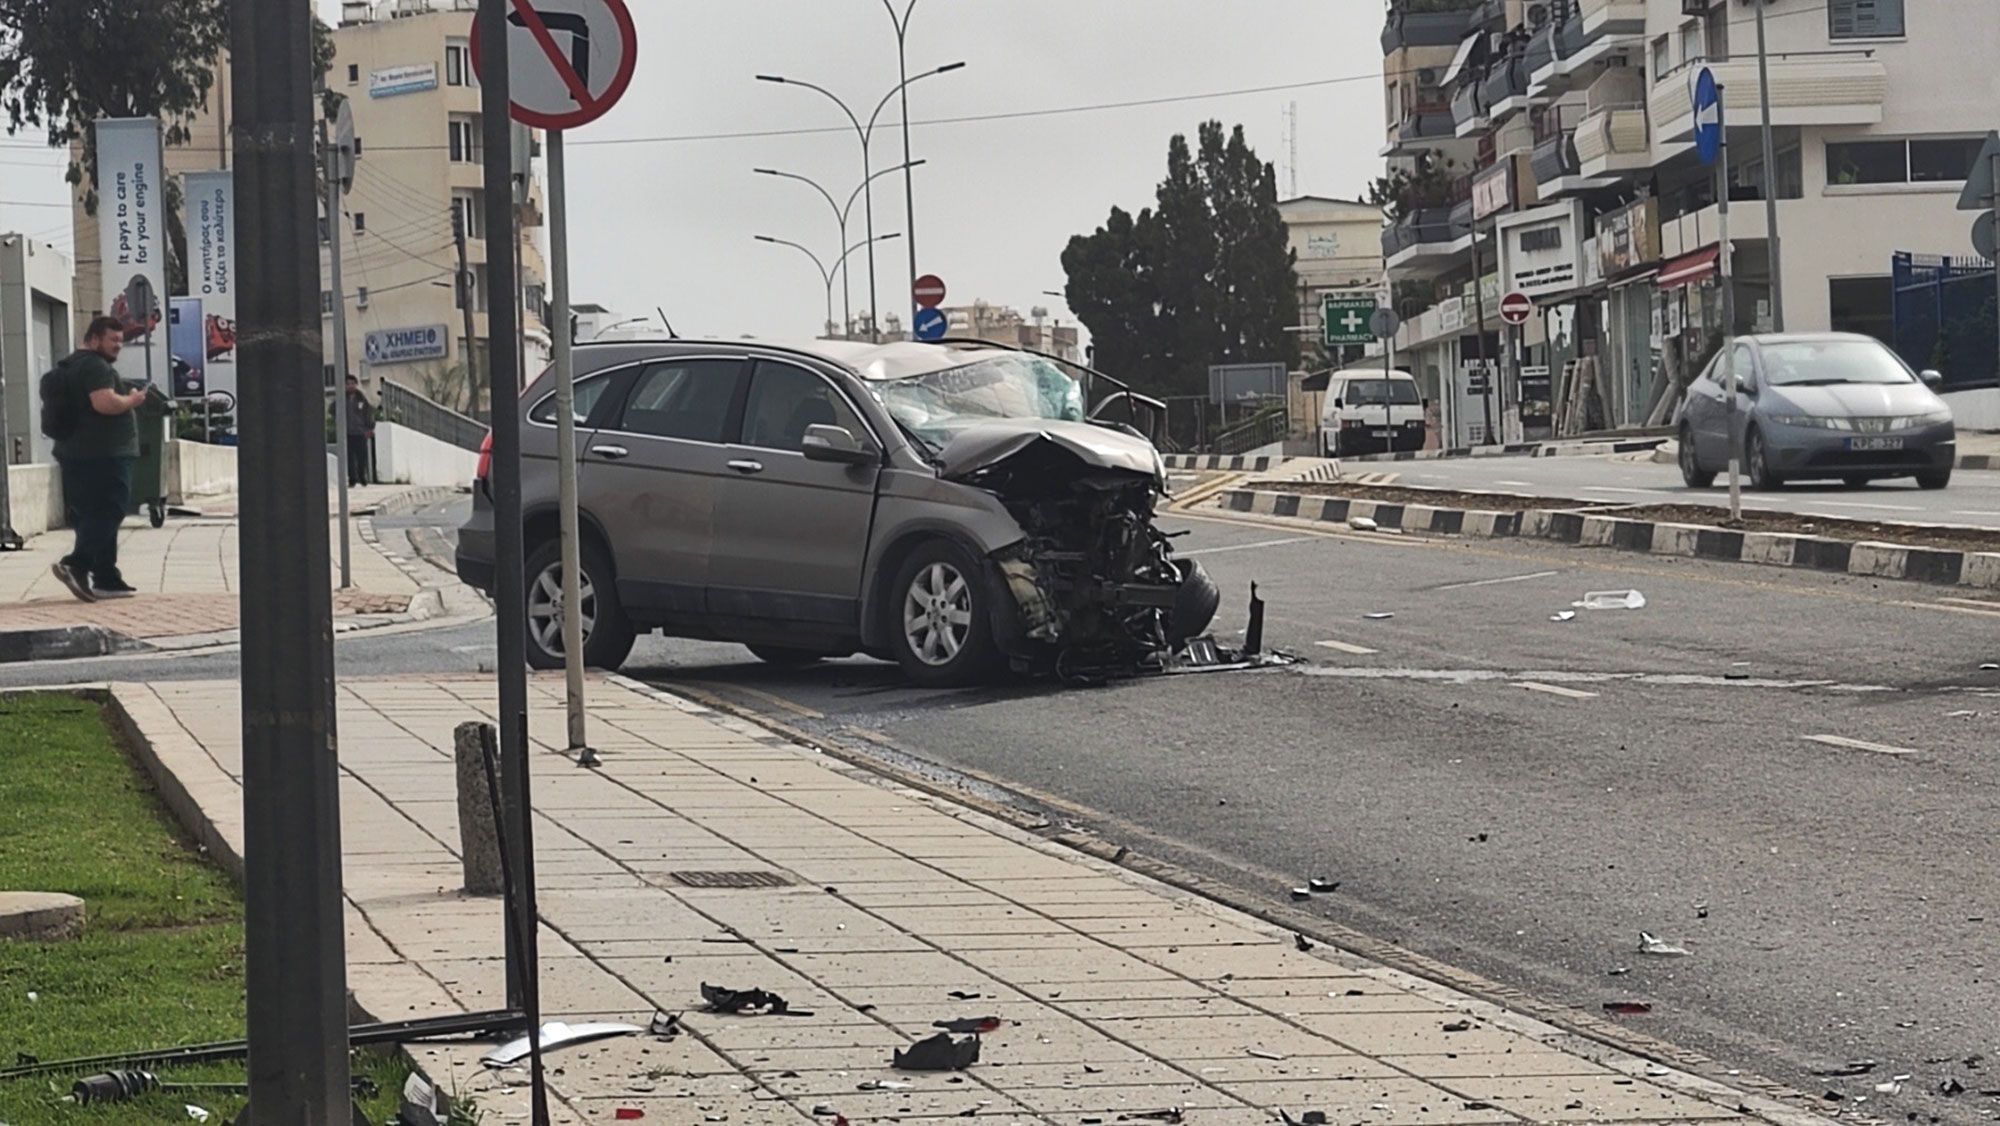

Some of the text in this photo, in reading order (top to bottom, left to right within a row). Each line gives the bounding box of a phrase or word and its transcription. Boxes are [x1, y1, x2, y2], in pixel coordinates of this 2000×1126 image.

[117, 173, 131, 264] It pays to care
[132, 163, 150, 264] for your engine
[201, 200, 210, 222] σου
[217, 245, 225, 258] το
[386, 329, 436, 347] ΧΗΜΕΙΟ
[1330, 333, 1373, 342] PHARMACY
